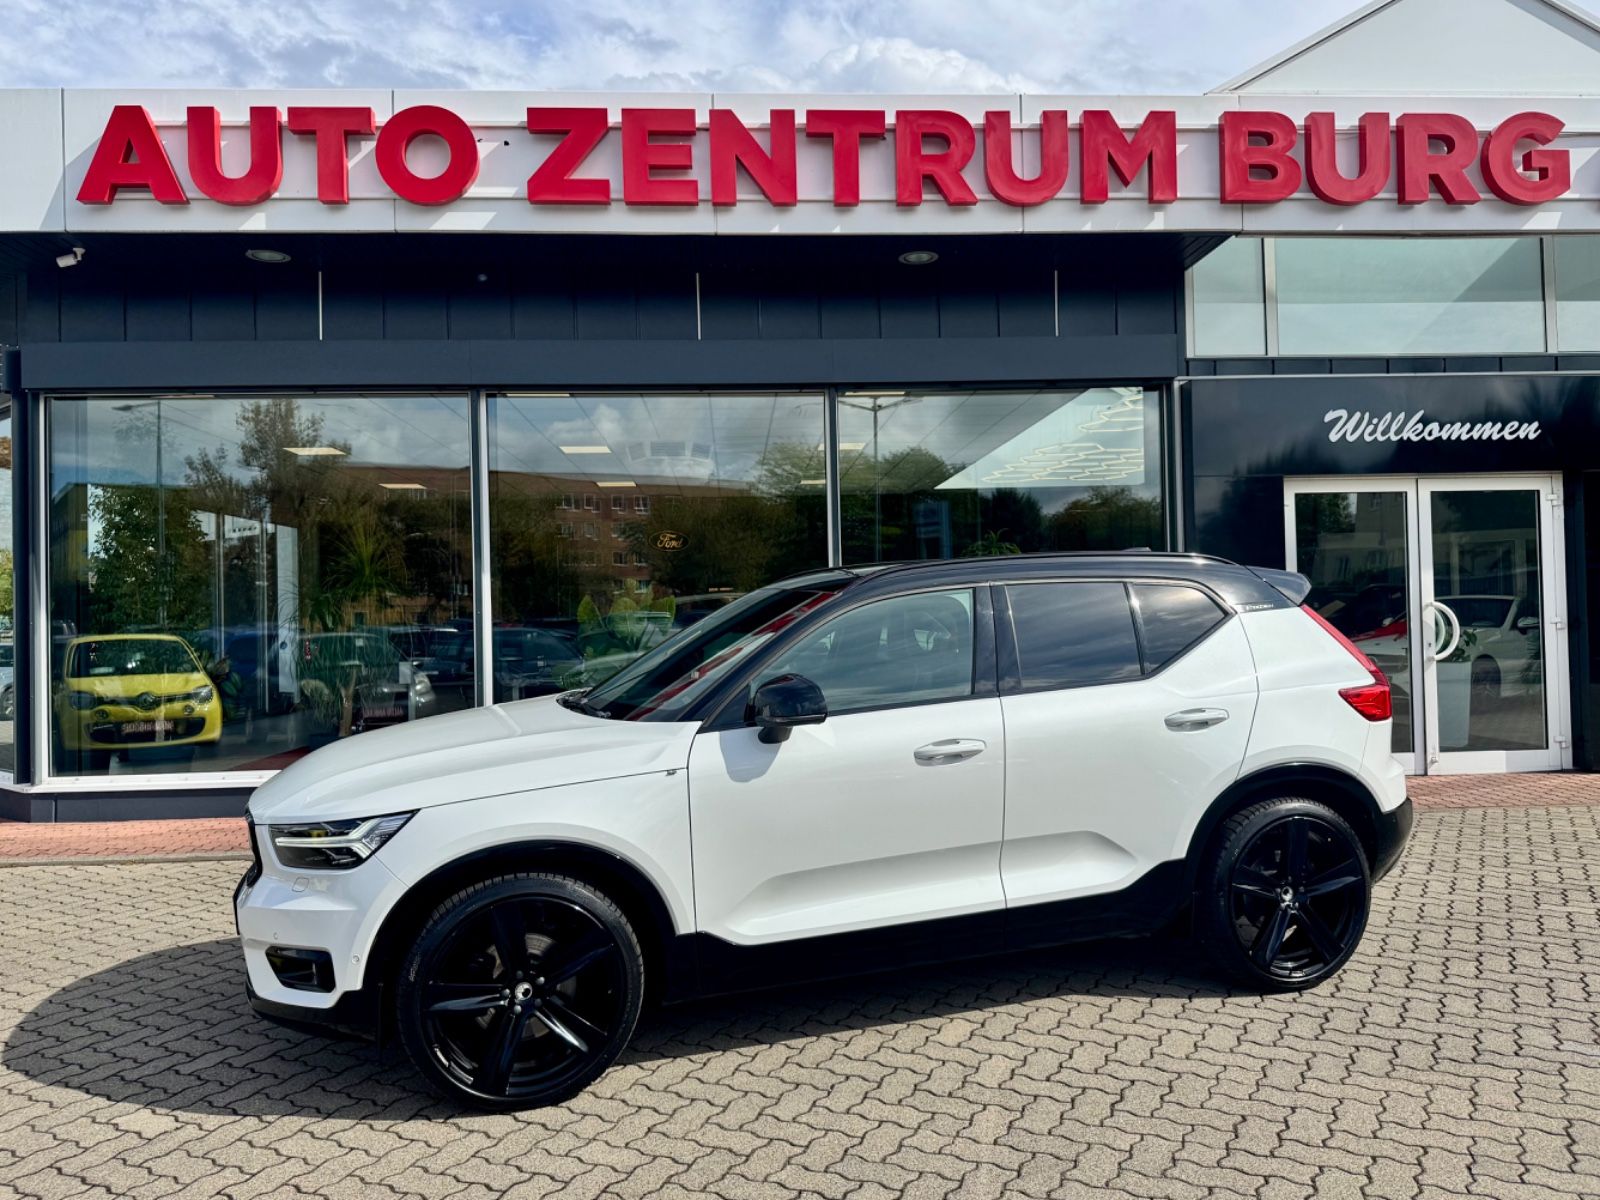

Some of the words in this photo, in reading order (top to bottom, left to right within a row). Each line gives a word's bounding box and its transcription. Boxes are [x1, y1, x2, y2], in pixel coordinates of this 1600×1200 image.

[77, 104, 480, 206] AUTO
[526, 107, 1178, 208] ZENTRUM
[1219, 110, 1571, 207] BURG
[1324, 408, 1541, 443] Willkommen
[657, 533, 684, 549] Ford
